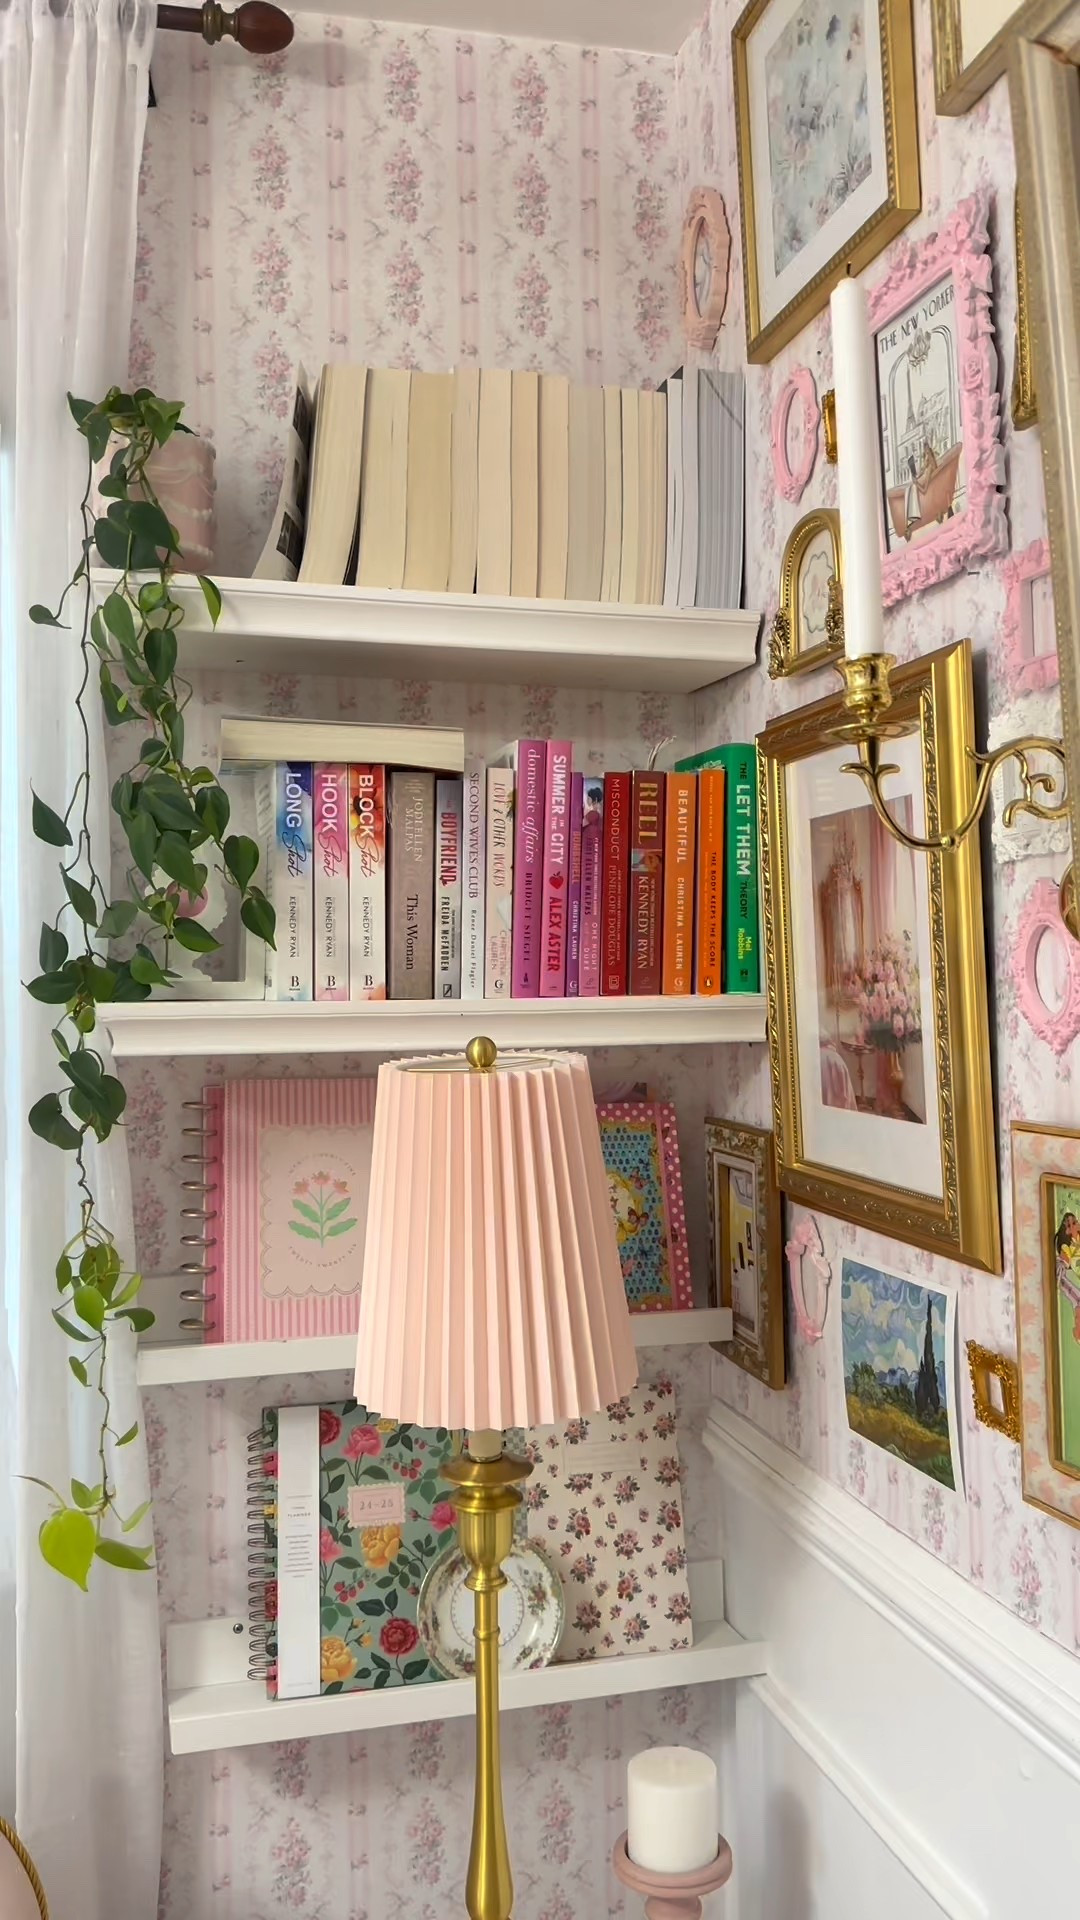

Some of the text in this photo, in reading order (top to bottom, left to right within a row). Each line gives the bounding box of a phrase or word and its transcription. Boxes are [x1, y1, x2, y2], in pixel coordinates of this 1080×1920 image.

[880, 284, 955, 353] THE NEW YORKER
[522, 750, 541, 864] domestic affairs
[552, 755, 567, 814] SUMMER
[639, 783, 658, 844] REEL
[736, 784, 751, 816] LET
[282, 773, 307, 877] LONG Shot
[318, 774, 342, 877] HOOK Shot
[356, 774, 379, 877] BLOCK Shot
[405, 808, 413, 852] MALPAS
[413, 796, 423, 862] JODI ELLEN
[440, 812, 457, 882] BOYFRIEND
[469, 772, 479, 898] SECOND WIVES CLUB
[493, 819, 506, 848] OTHER
[551, 833, 564, 864] CITY
[611, 779, 620, 860] MISCONDUCT
[677, 790, 689, 863] BEAUTIFUL
[736, 823, 751, 875] THEM
[493, 853, 506, 887] WORDS
[572, 831, 581, 884] BOMBSHELL
[525, 872, 533, 918] BRIDGET
[584, 886, 592, 915] MALPAS
[608, 865, 617, 966] PENELOPE DOUGLAS
[637, 877, 649, 968] KENNEDY RYAN
[676, 877, 685, 927] CHRISTINA
[740, 881, 748, 919] THEORY
[406, 894, 418, 970] This Woman
[440, 897, 450, 971] FREIDA McFADDEN
[490, 936, 498, 970] LAUREN
[547, 896, 562, 971] ALEX ASTER
